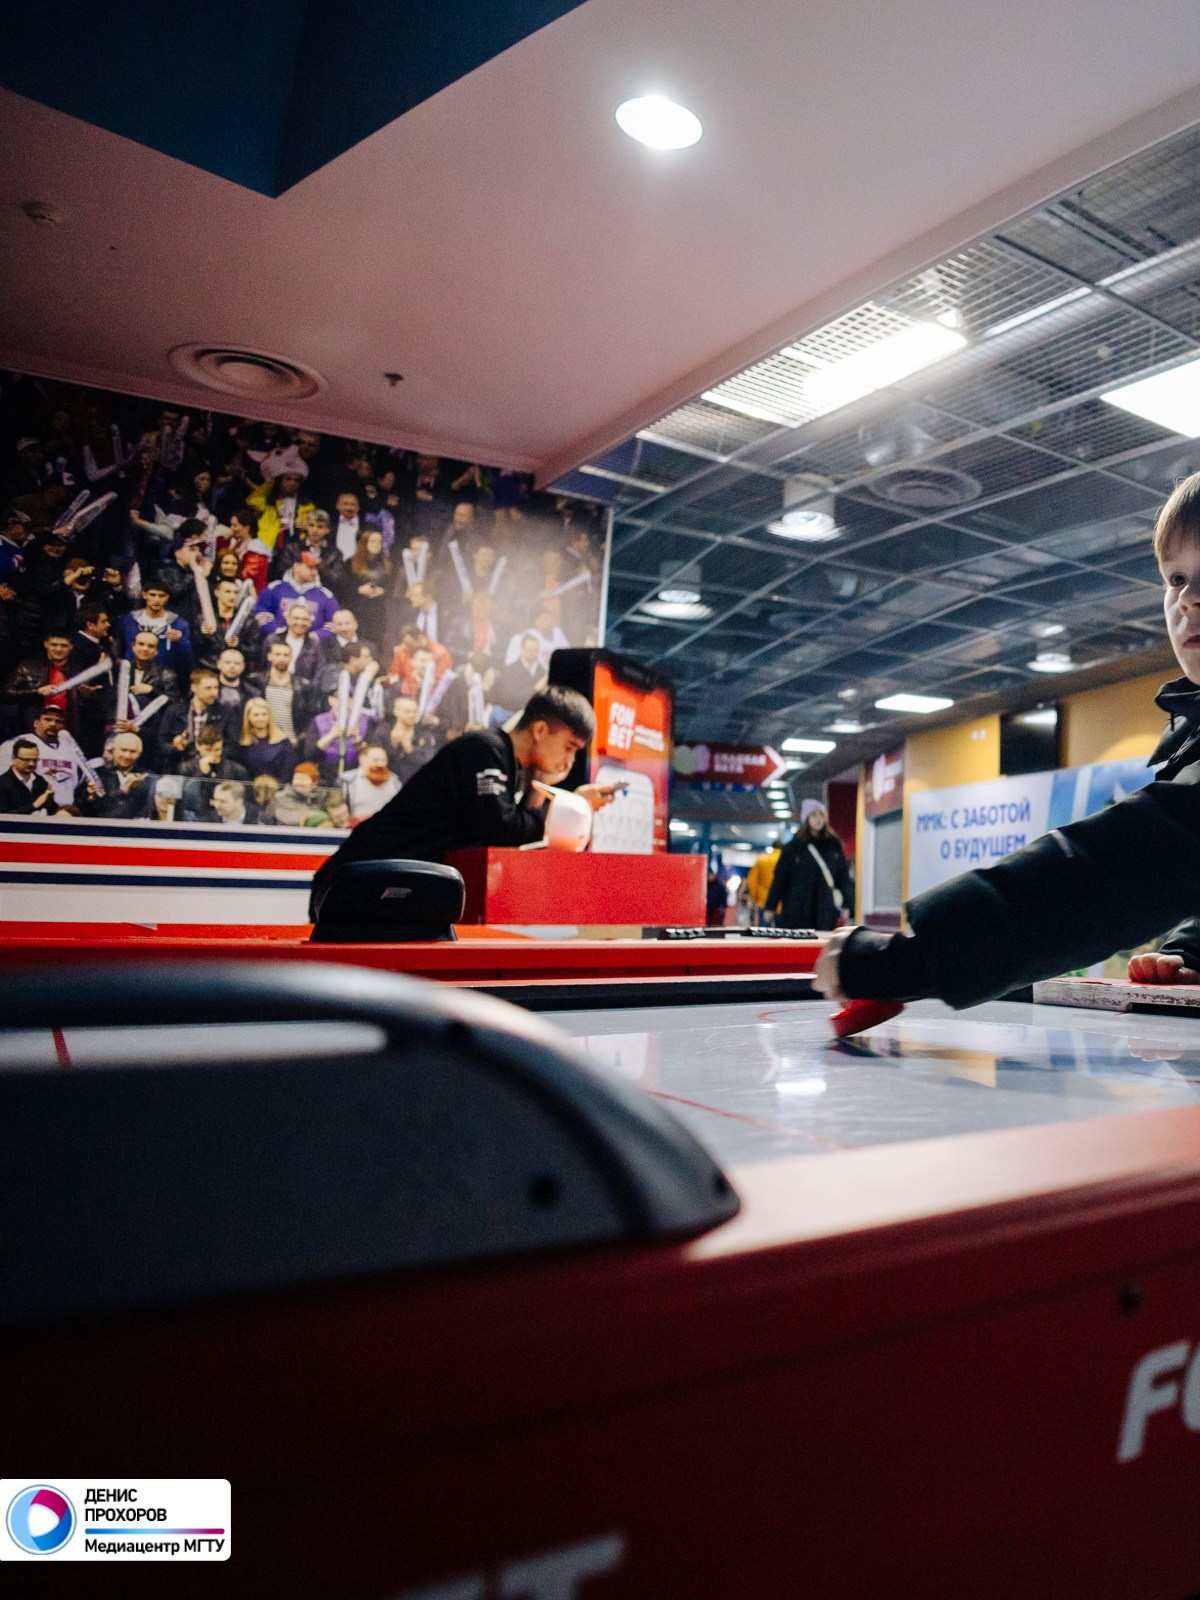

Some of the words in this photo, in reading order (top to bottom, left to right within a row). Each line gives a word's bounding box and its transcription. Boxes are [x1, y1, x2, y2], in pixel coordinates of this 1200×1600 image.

[609, 702, 636, 728] FON
[608, 722, 634, 750] BET
[951, 808, 959, 829] С
[962, 797, 1031, 828] ЗАБОТОЙ
[941, 840, 949, 860] О
[954, 834, 1026, 862] БУДУЩЕМ
